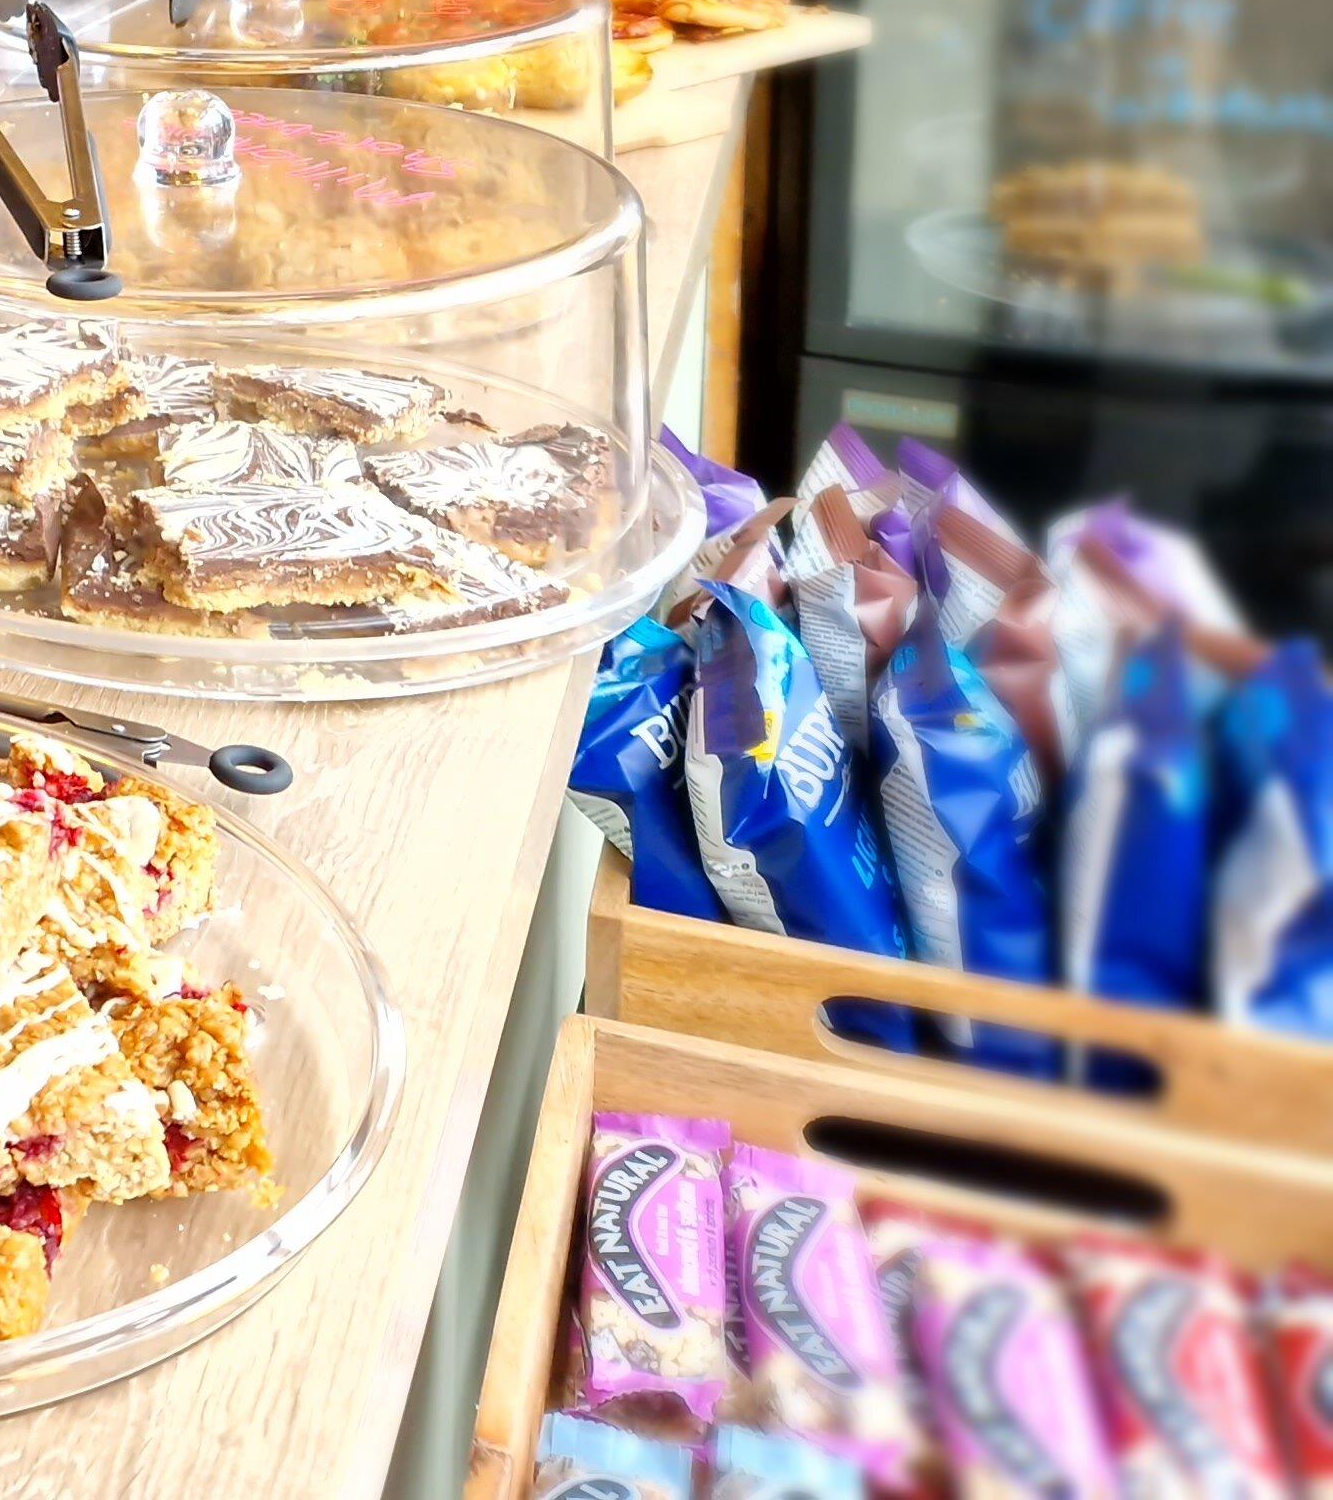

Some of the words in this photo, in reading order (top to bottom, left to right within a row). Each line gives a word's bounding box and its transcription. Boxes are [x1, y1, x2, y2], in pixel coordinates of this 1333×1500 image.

[592, 1150, 669, 1254] NATURAL
[606, 1258, 671, 1316] EAT
[751, 1200, 821, 1314] NATURAL
[776, 1317, 852, 1377] EAT
